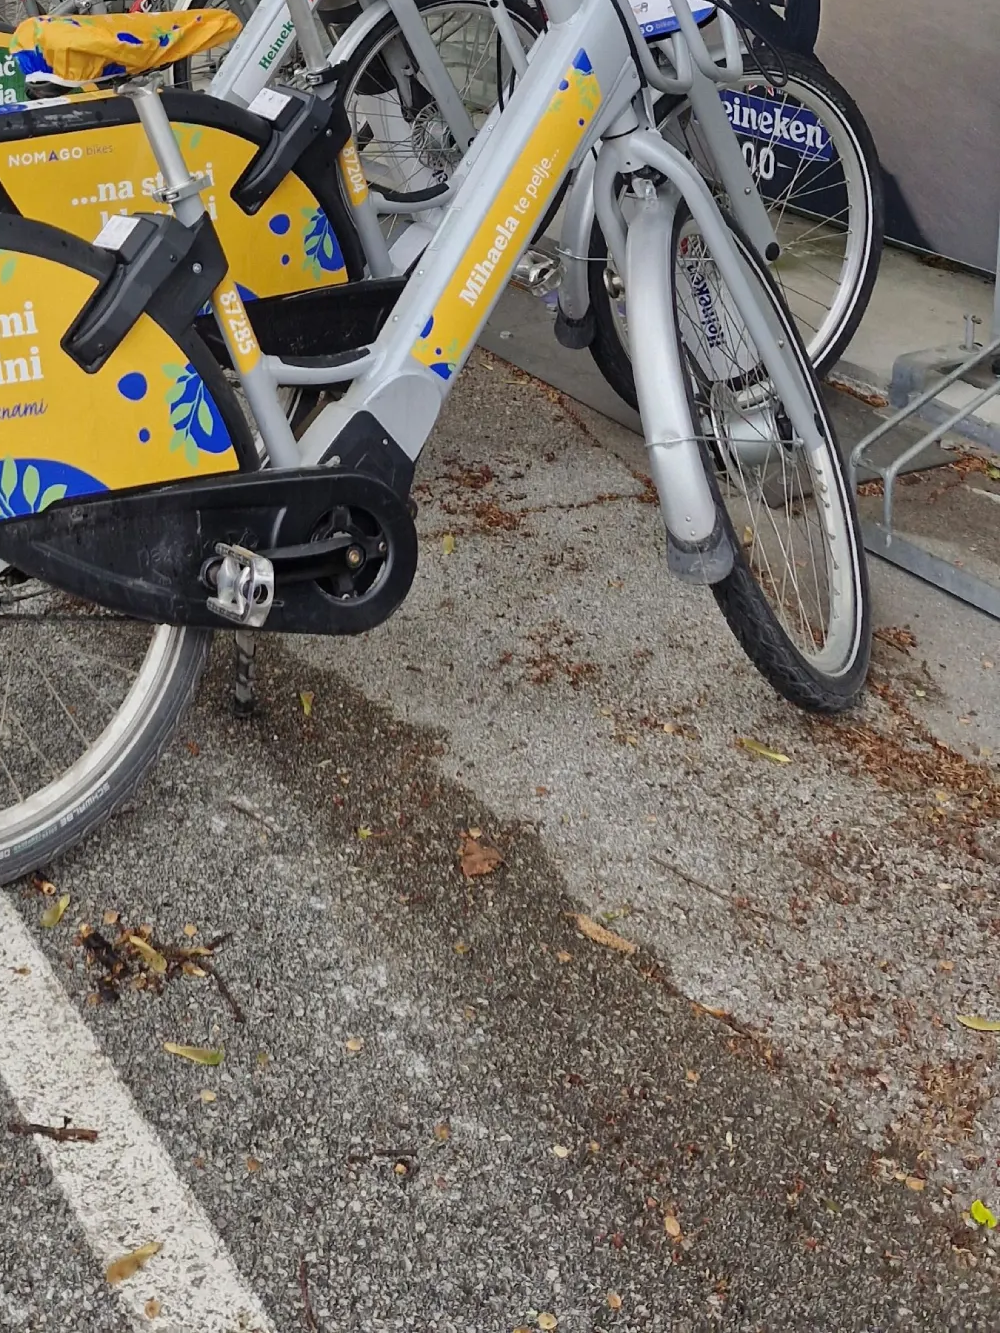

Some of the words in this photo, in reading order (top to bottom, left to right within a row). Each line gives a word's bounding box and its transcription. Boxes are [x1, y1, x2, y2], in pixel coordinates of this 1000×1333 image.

[258, 20, 295, 71] Heinek
[722, 97, 825, 149] eineken
[8, 147, 83, 167] NOMAGO
[86, 144, 113, 156] bikes
[343, 147, 365, 194] 87204
[71, 179, 134, 206] ...na
[142, 162, 215, 196] sti
[459, 215, 520, 307] Mihaela
[513, 197, 530, 214] te
[220, 290, 256, 355] 87285
[60, 782, 111, 827] SCHWALBE
